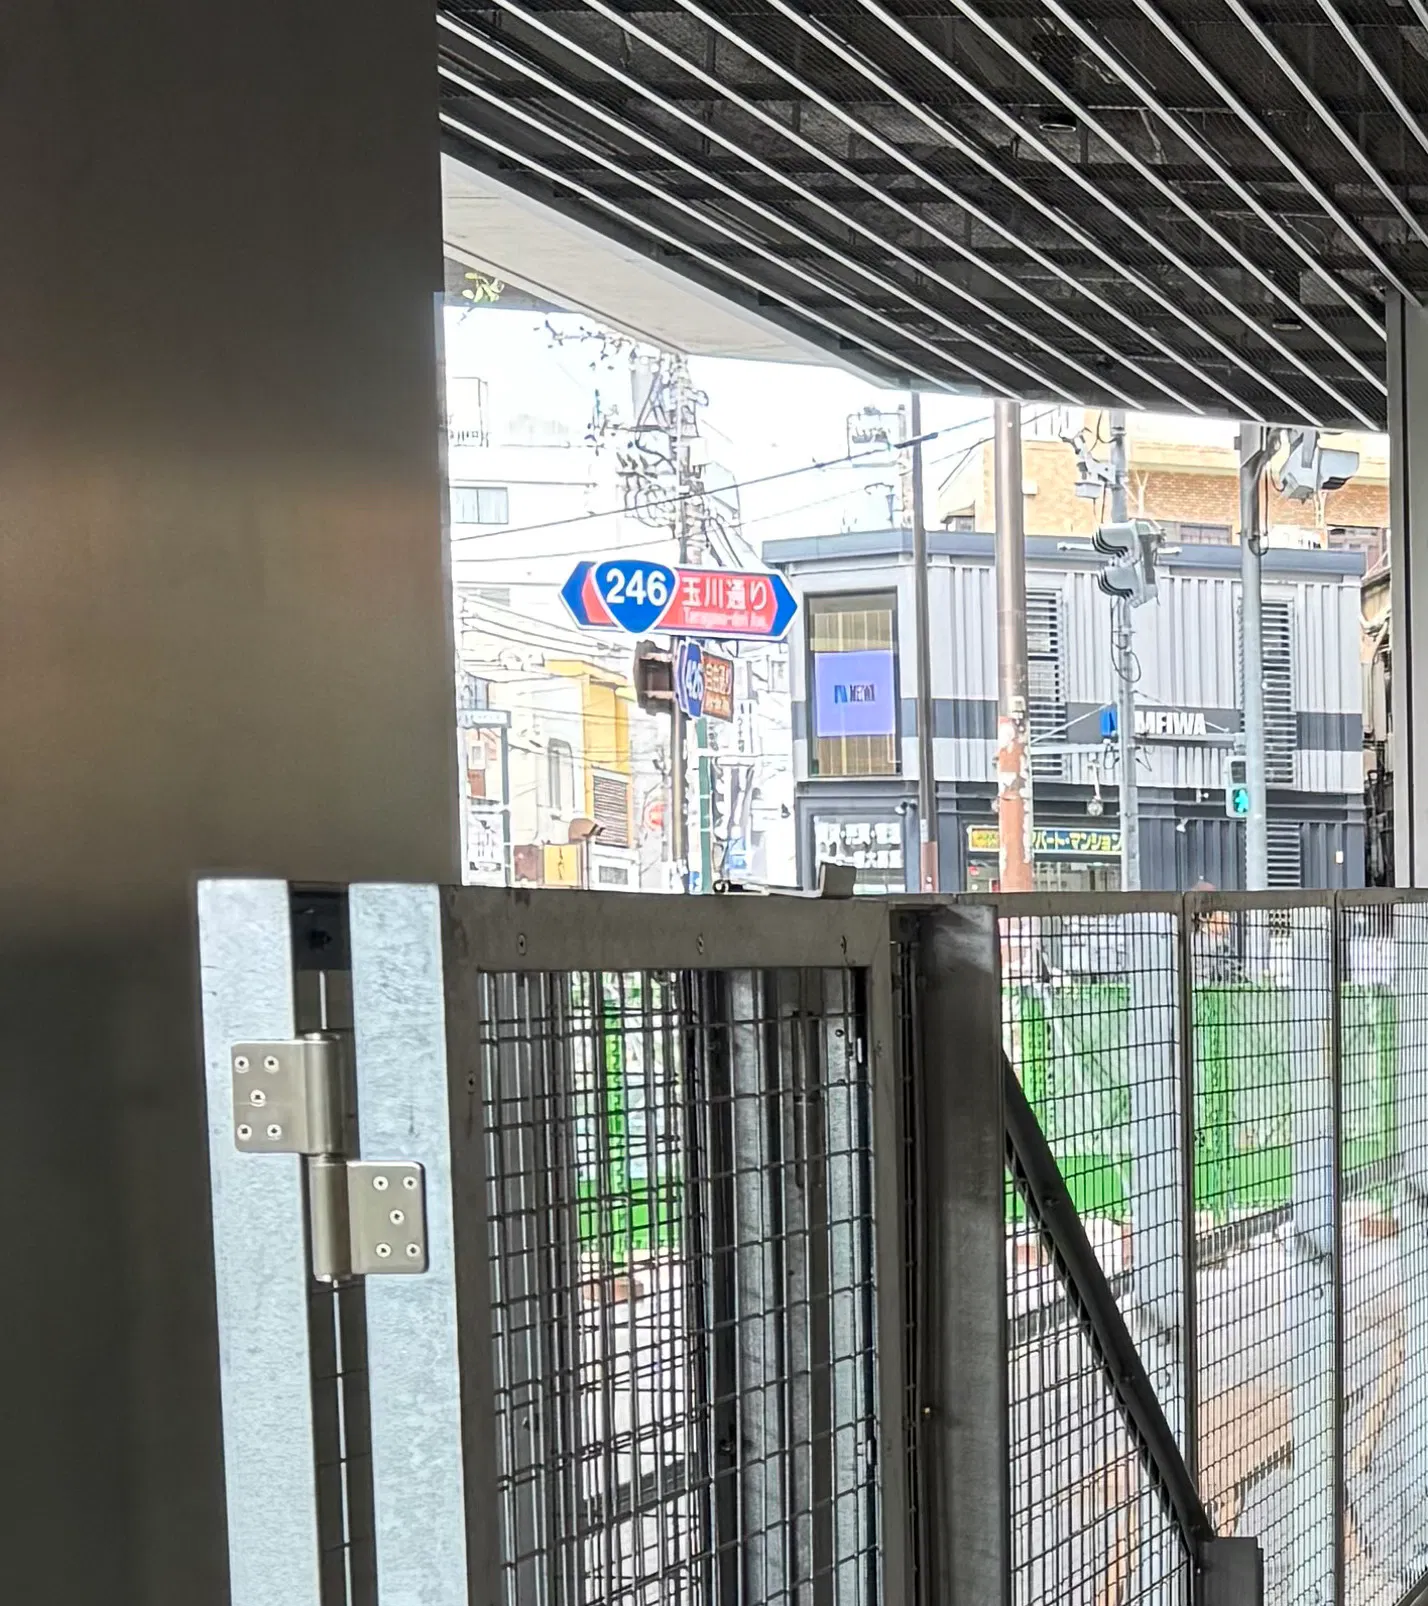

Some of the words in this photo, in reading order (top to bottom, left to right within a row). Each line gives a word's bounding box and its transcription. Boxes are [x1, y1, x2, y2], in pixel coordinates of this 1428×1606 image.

[606, 568, 668, 607] 246
[681, 576, 767, 611] 玉川通り
